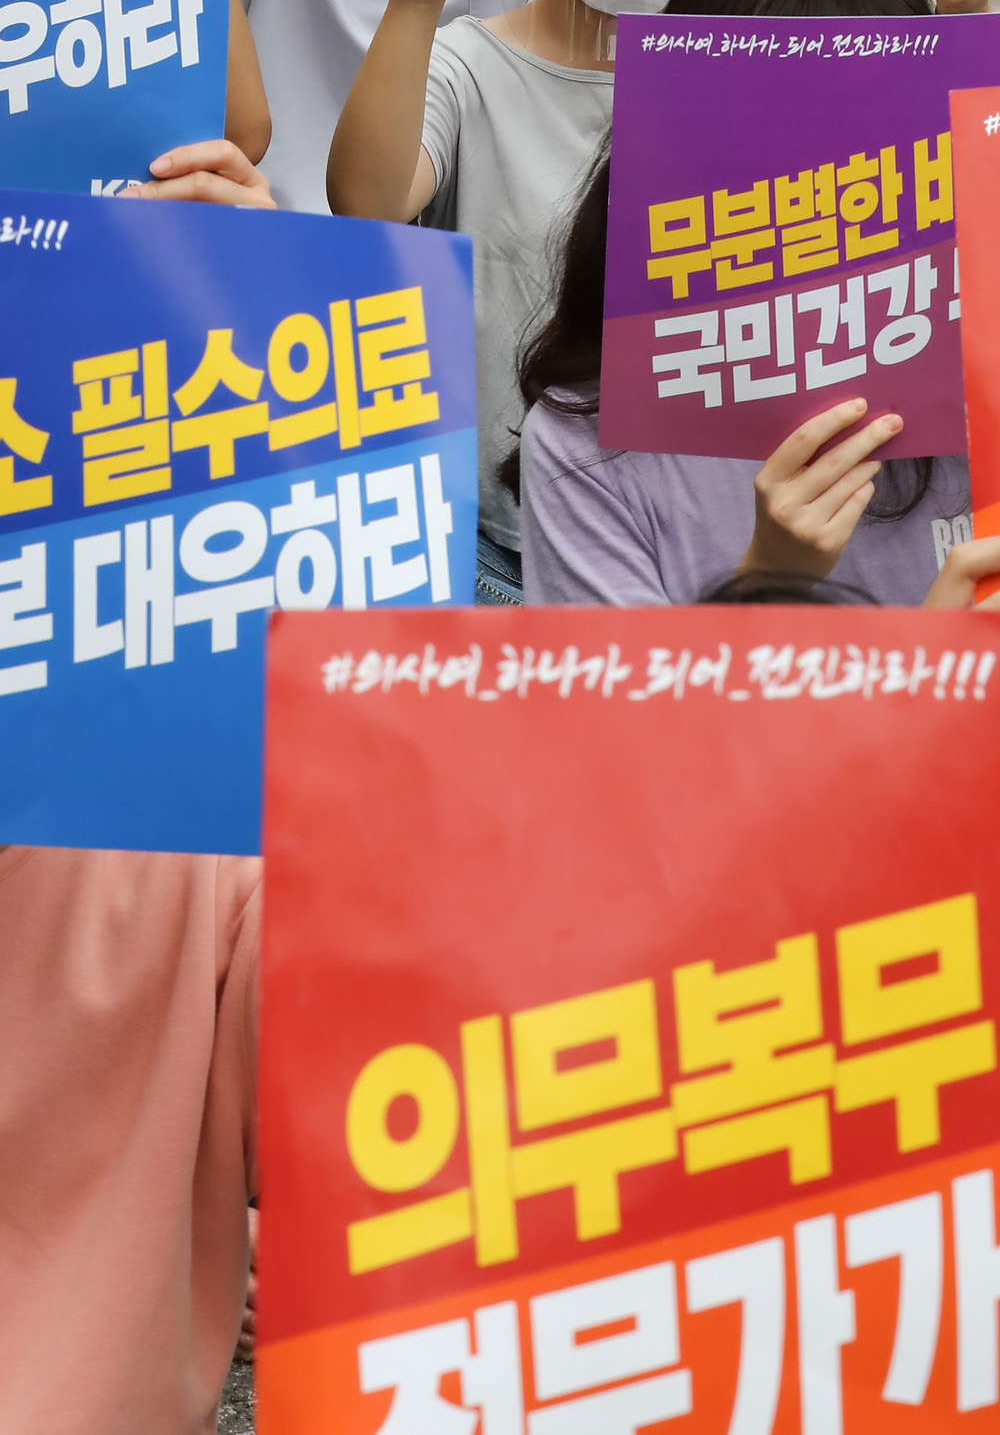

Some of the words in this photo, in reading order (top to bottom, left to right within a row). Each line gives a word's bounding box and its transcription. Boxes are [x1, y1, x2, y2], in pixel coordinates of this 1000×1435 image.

[640, 31, 941, 60] #의사여_하나가_되어_전진하라!!!
[646, 142, 904, 301] 무분별한
[70, 284, 441, 509] 필수의료
[650, 252, 940, 410] 국민건강
[72, 453, 452, 672] 대우하라
[320, 641, 997, 701] #의사여_하나가_되어_전진하라!!!
[343, 891, 999, 1277] 의무복무
